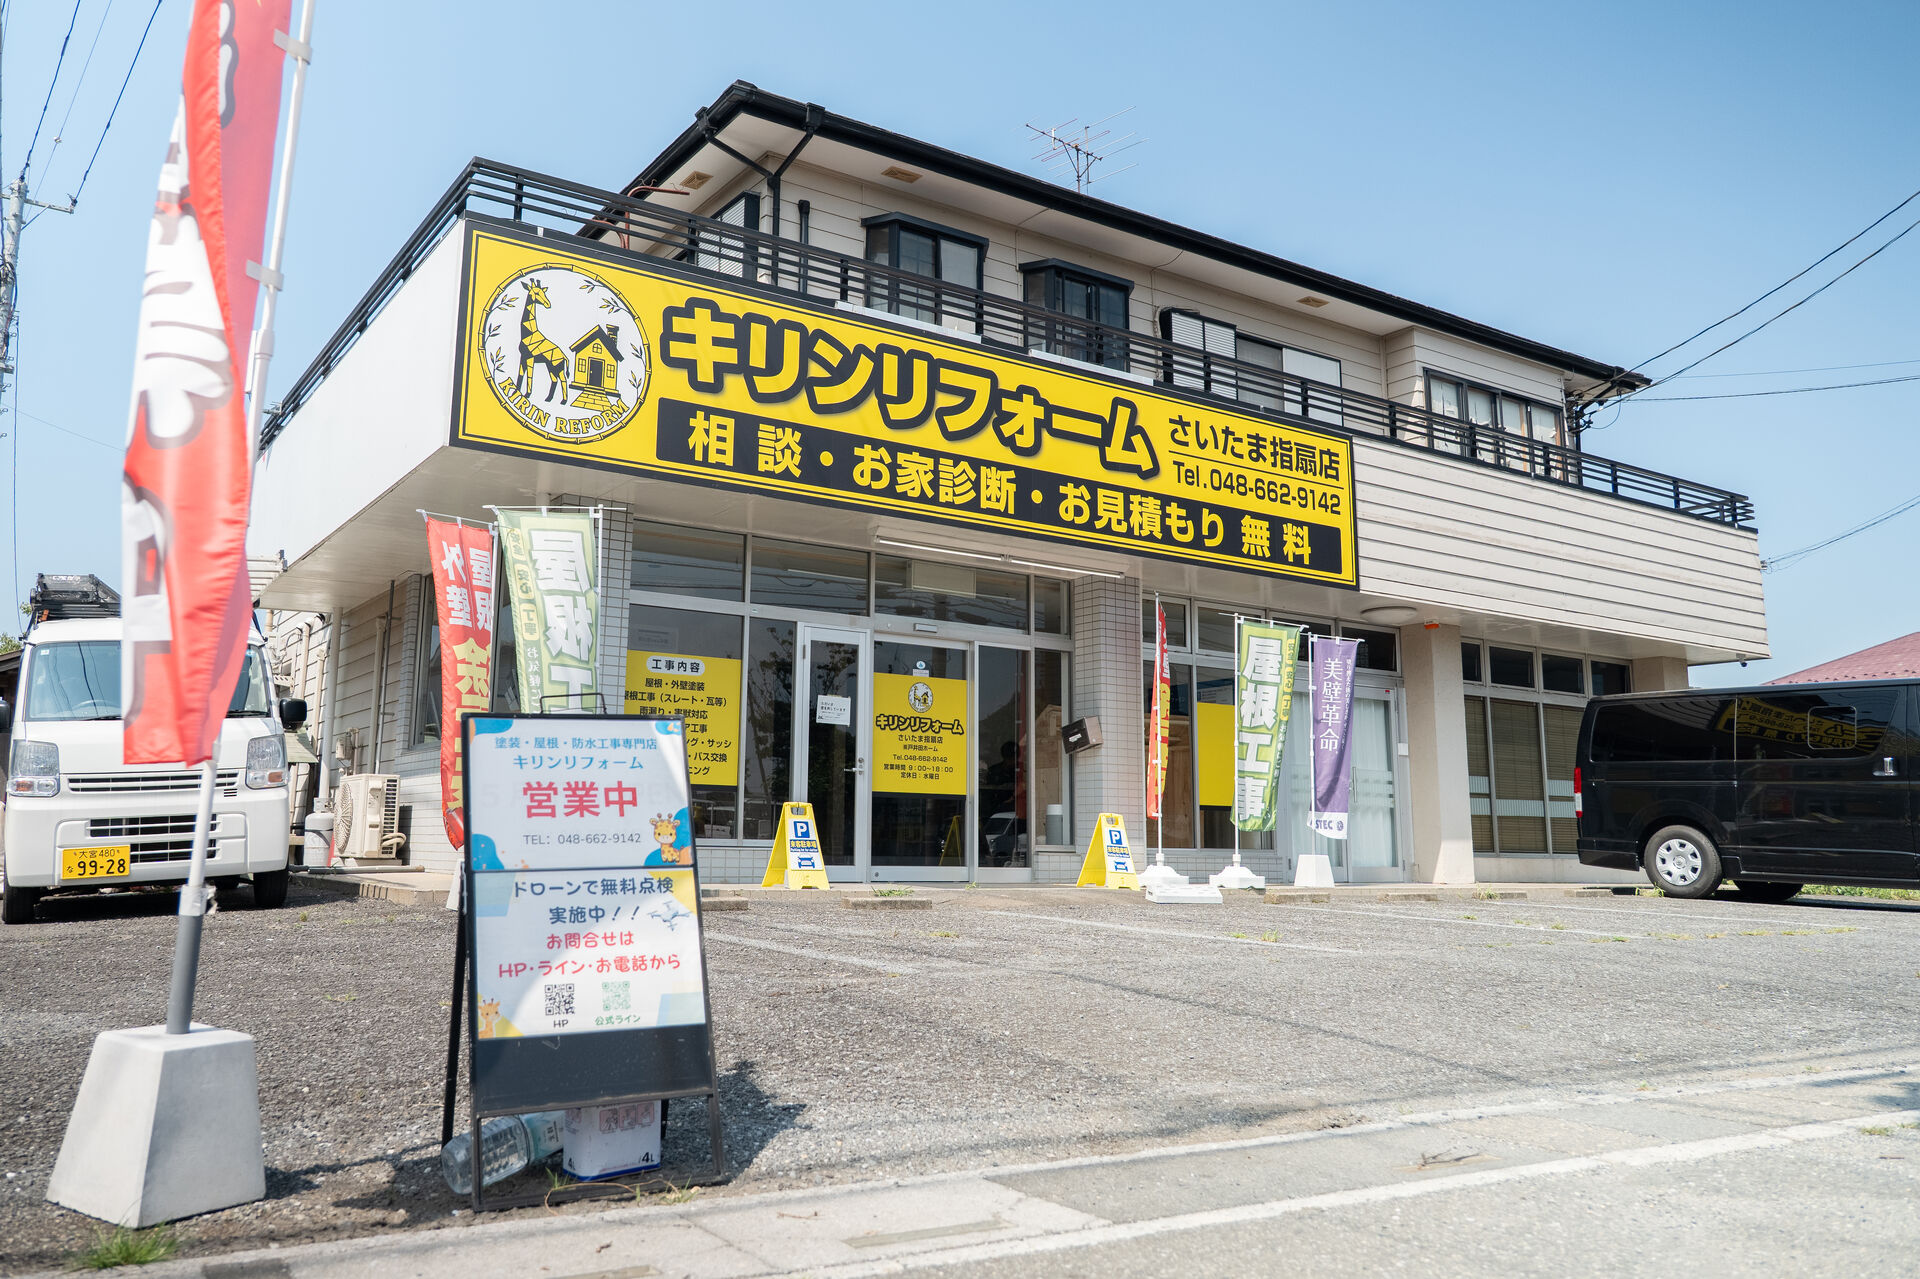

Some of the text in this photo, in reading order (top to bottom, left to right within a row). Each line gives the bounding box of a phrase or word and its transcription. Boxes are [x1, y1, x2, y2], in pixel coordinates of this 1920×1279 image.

[661, 299, 1158, 478] キリンリフォーム
[498, 376, 630, 434] KIRIN REFORM
[1168, 414, 1340, 482] さいたま指扇店
[652, 658, 700, 673] 工事内容
[644, 677, 705, 692] 屋根・外壁塗装
[875, 713, 965, 736] キリンリフォーム
[1238, 635, 1283, 820] 屋根工事
[494, 736, 658, 751] 塗装・屋根・防水工事専門店
[512, 754, 644, 771] キリンリフォーム
[522, 780, 638, 819] 営業中
[79, 848, 116, 859] 大宮 480
[77, 858, 126, 876] 99-28
[514, 876, 675, 898] ドローンで無料点検
[546, 930, 635, 950] お問合せは
[498, 953, 681, 979] HP・ライン・お電話から
[553, 1019, 569, 1028] HP
[595, 1014, 641, 1027] 公式ライン
